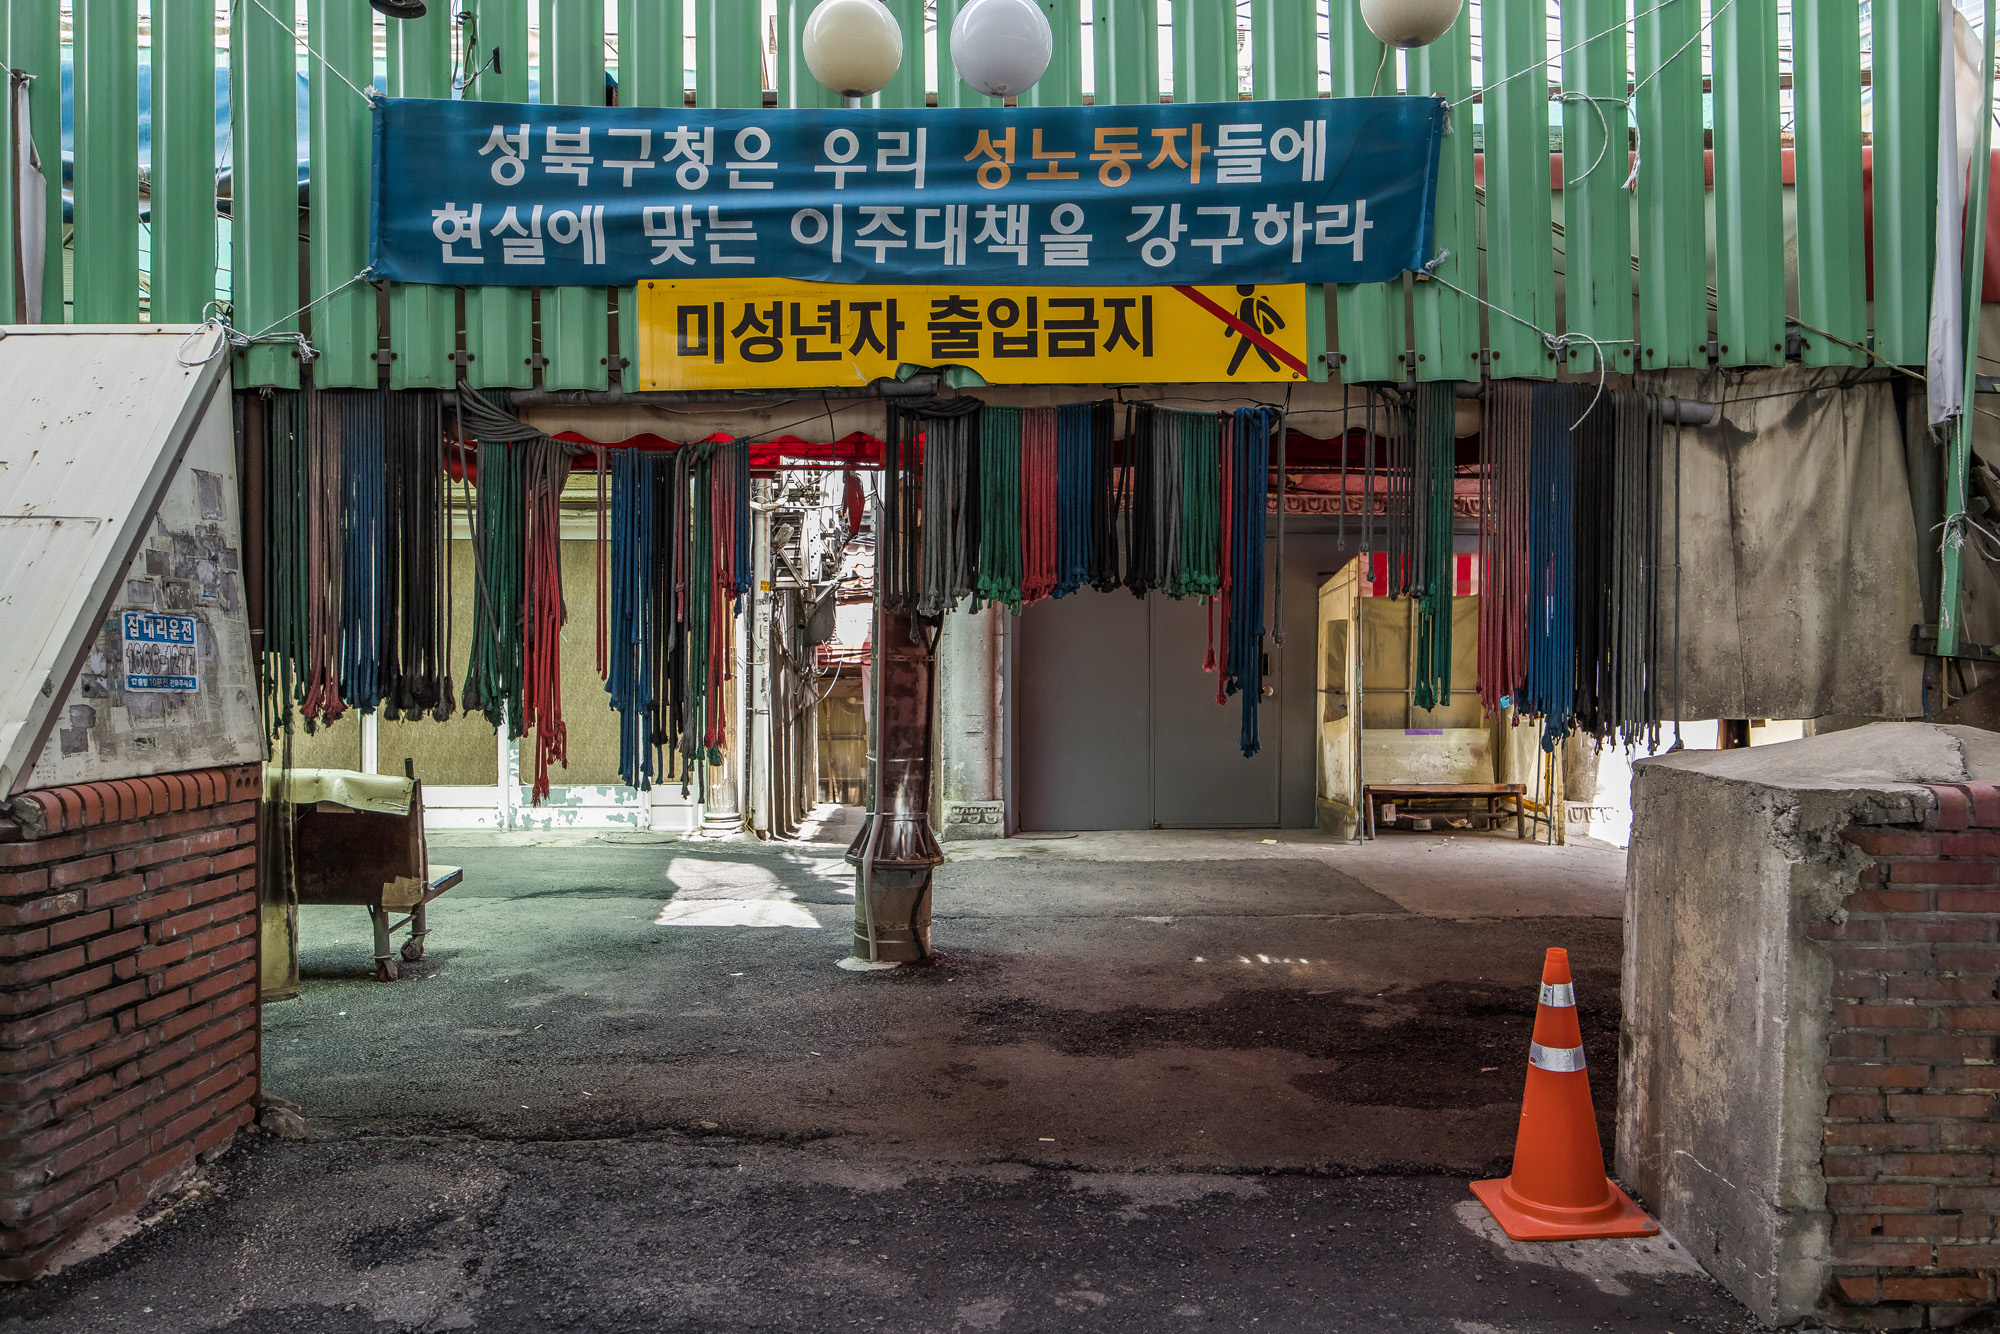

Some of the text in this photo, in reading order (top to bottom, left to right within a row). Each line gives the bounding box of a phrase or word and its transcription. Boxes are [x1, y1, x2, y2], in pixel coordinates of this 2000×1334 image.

[478, 119, 1327, 191] 성북구청은 우리 성노동자들에
[431, 199, 1374, 268] 현실에 맞는 이주대책을 강구하라
[676, 294, 1154, 365] 미성년자 출입금지
[126, 642, 196, 676] 1666-1277
